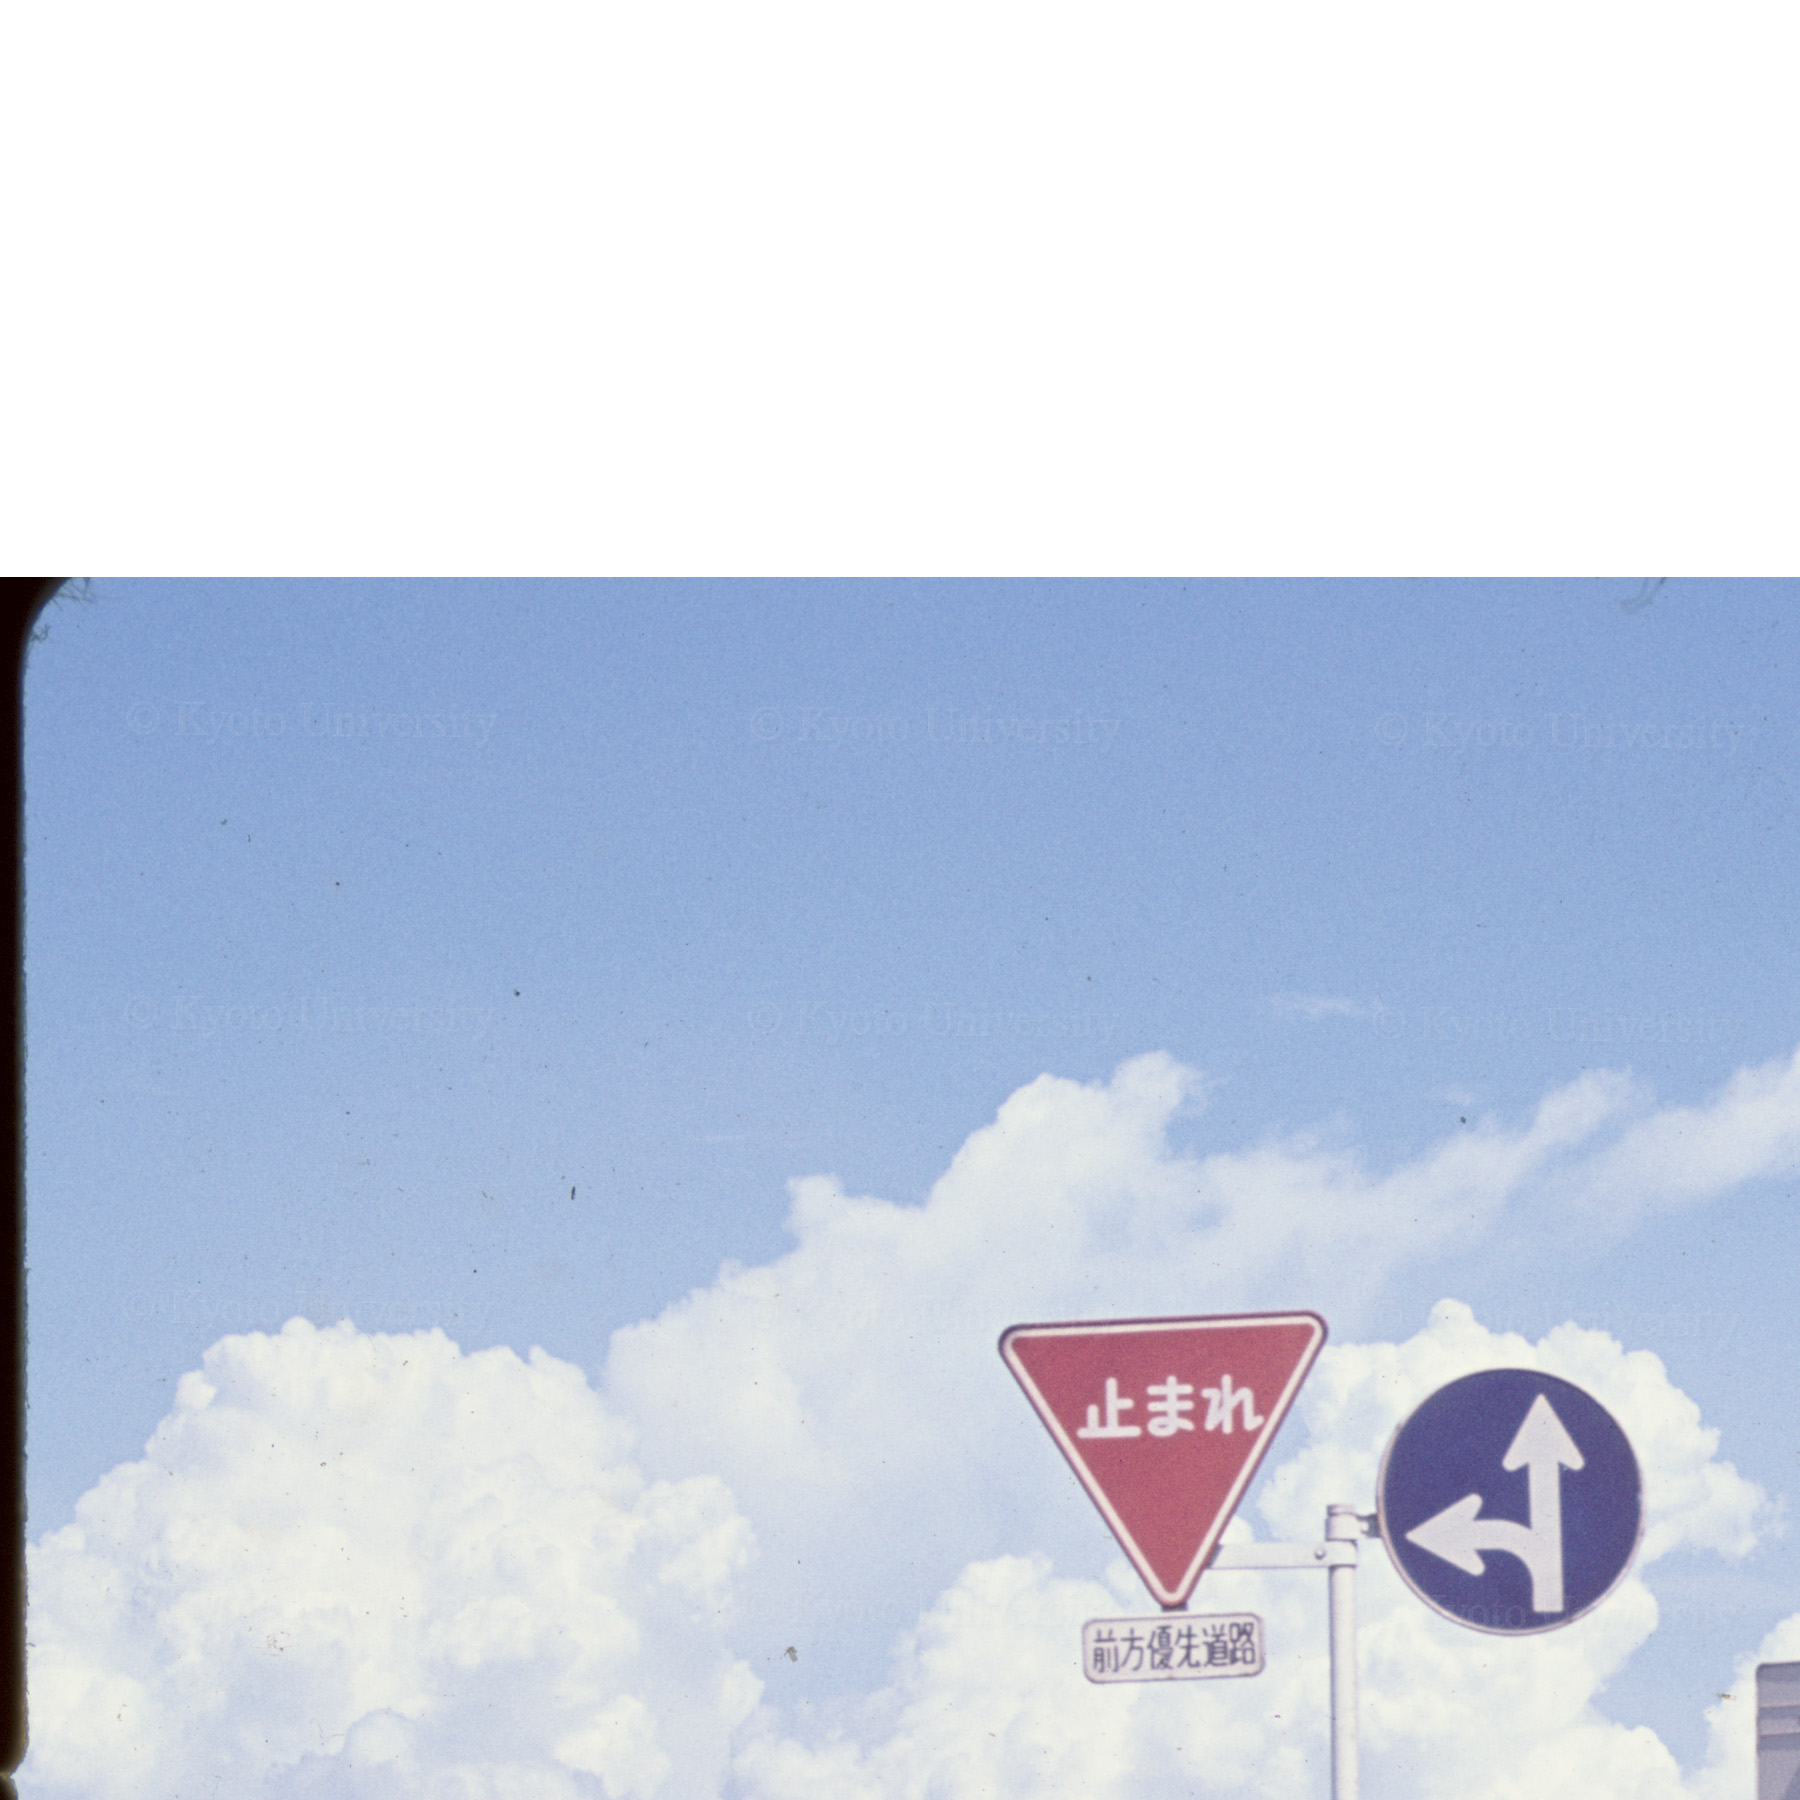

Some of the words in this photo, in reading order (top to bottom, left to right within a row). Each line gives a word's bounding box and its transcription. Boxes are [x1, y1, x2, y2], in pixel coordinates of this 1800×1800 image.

[1076, 1373, 1265, 1439] 止まれ
[1091, 1621, 1257, 1674] 前方優先道路
